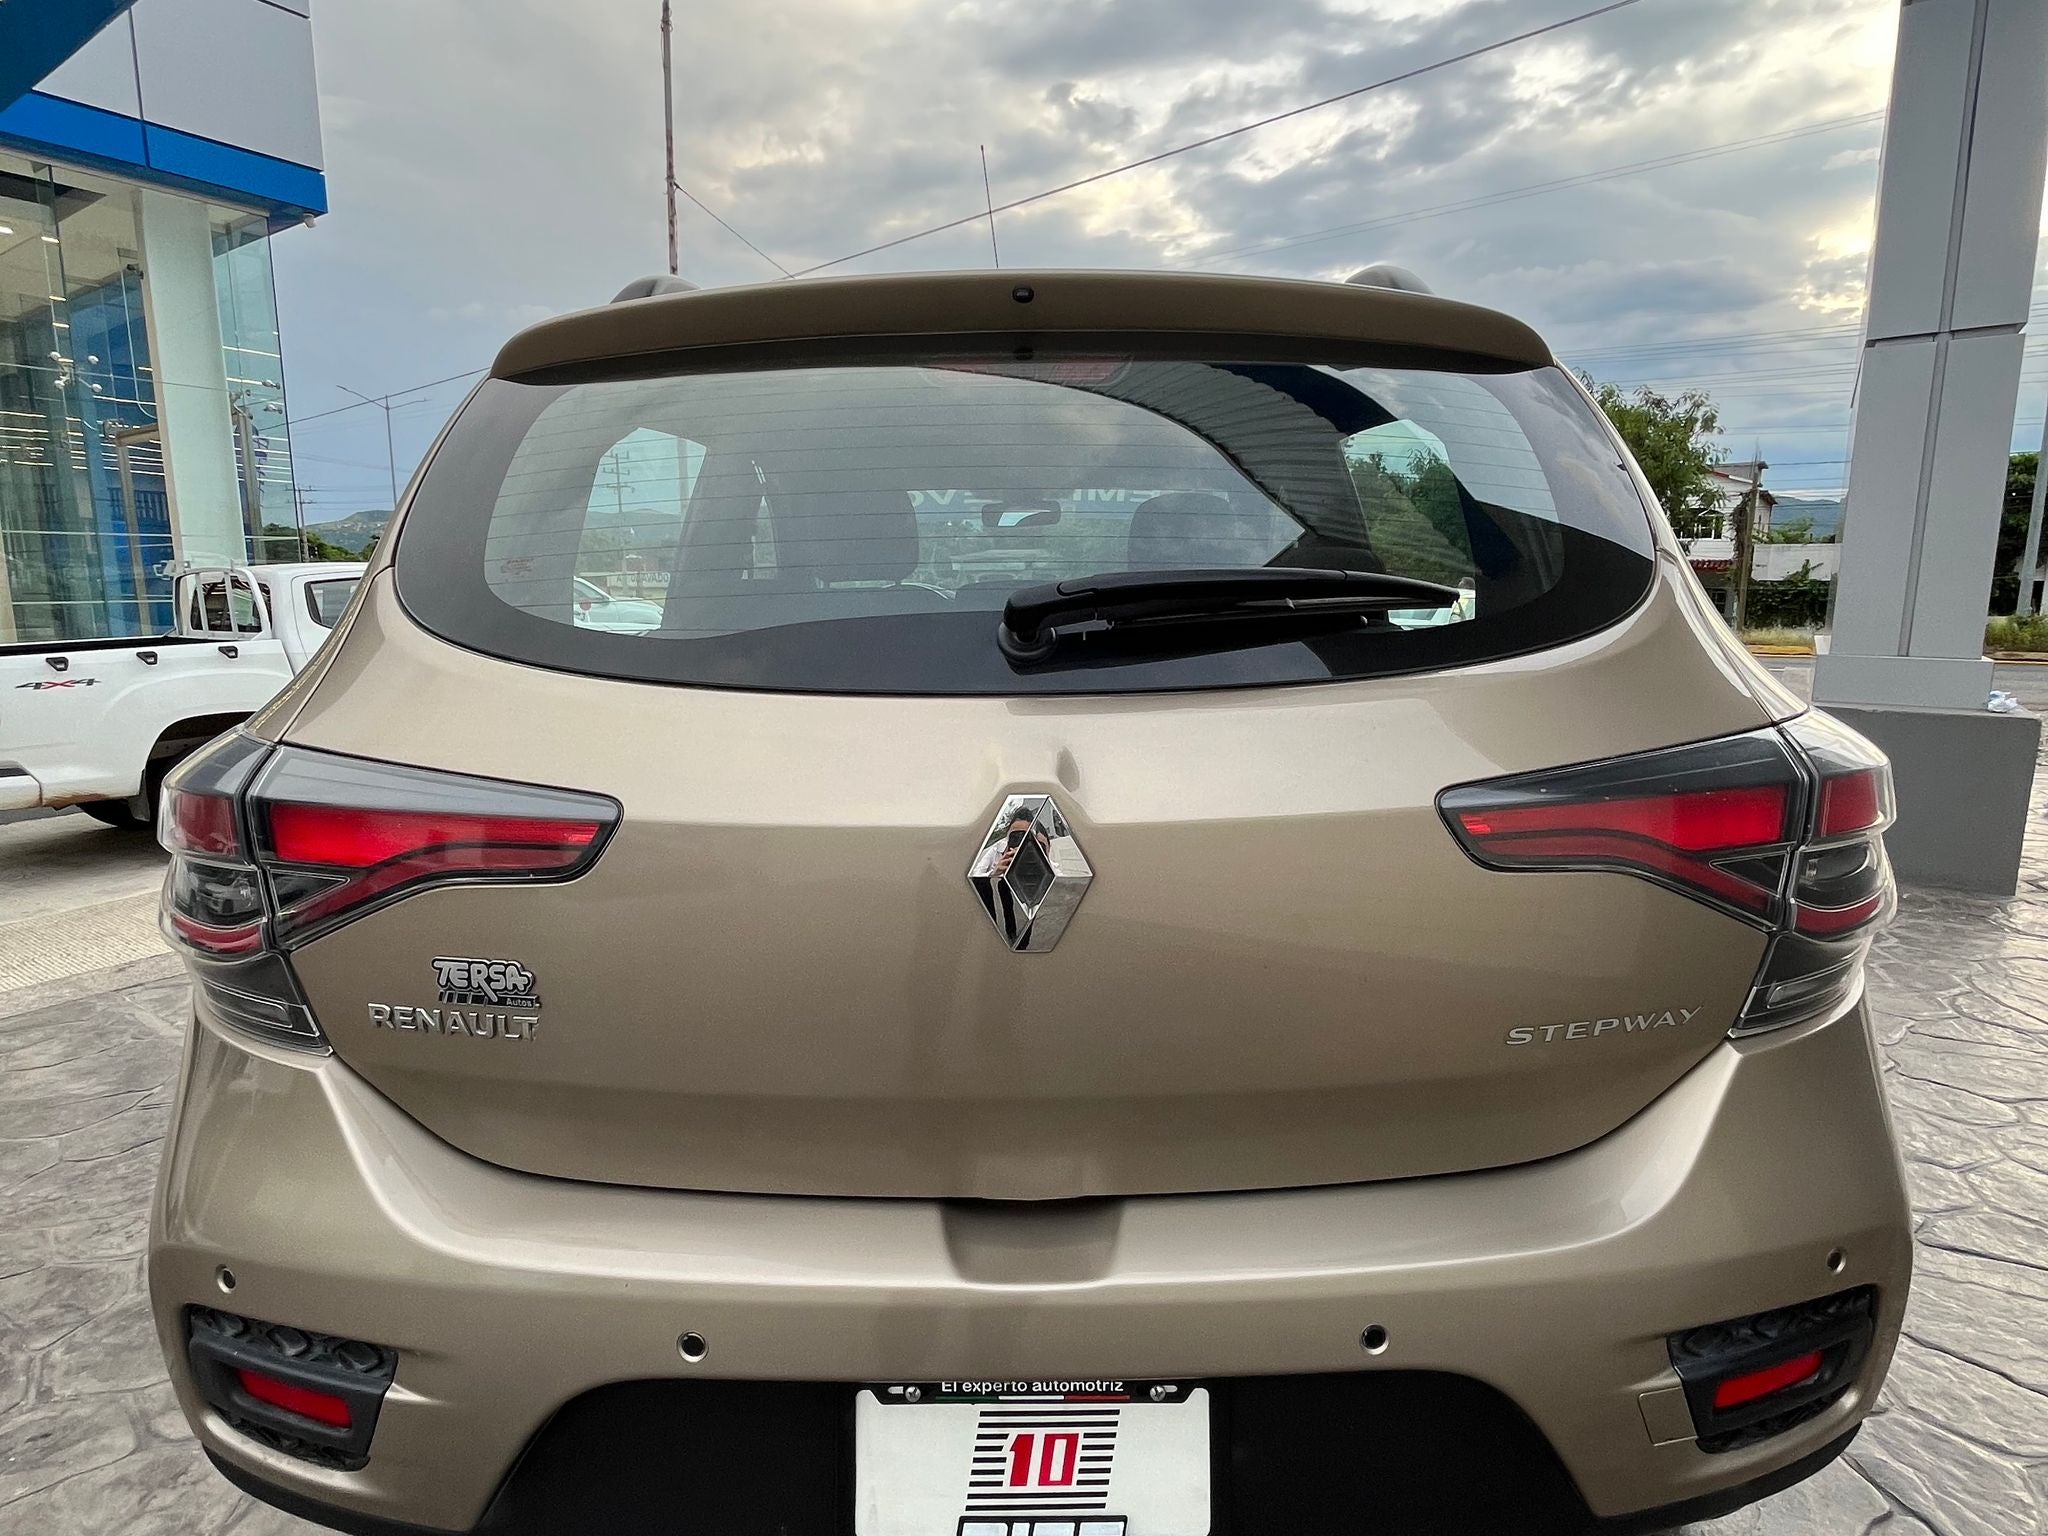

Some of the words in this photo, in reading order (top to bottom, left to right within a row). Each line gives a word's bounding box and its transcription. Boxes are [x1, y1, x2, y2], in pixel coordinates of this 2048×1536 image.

[432, 957, 533, 1002] TERSA
[368, 1002, 540, 1040] RENAULT
[506, 997, 532, 1008] Autos
[1506, 1005, 1705, 1045] STEPWAY
[941, 1380, 957, 1393] El
[962, 1381, 1028, 1395] experto
[1032, 1380, 1124, 1393] automotriz
[1009, 1433, 1079, 1486] 10
